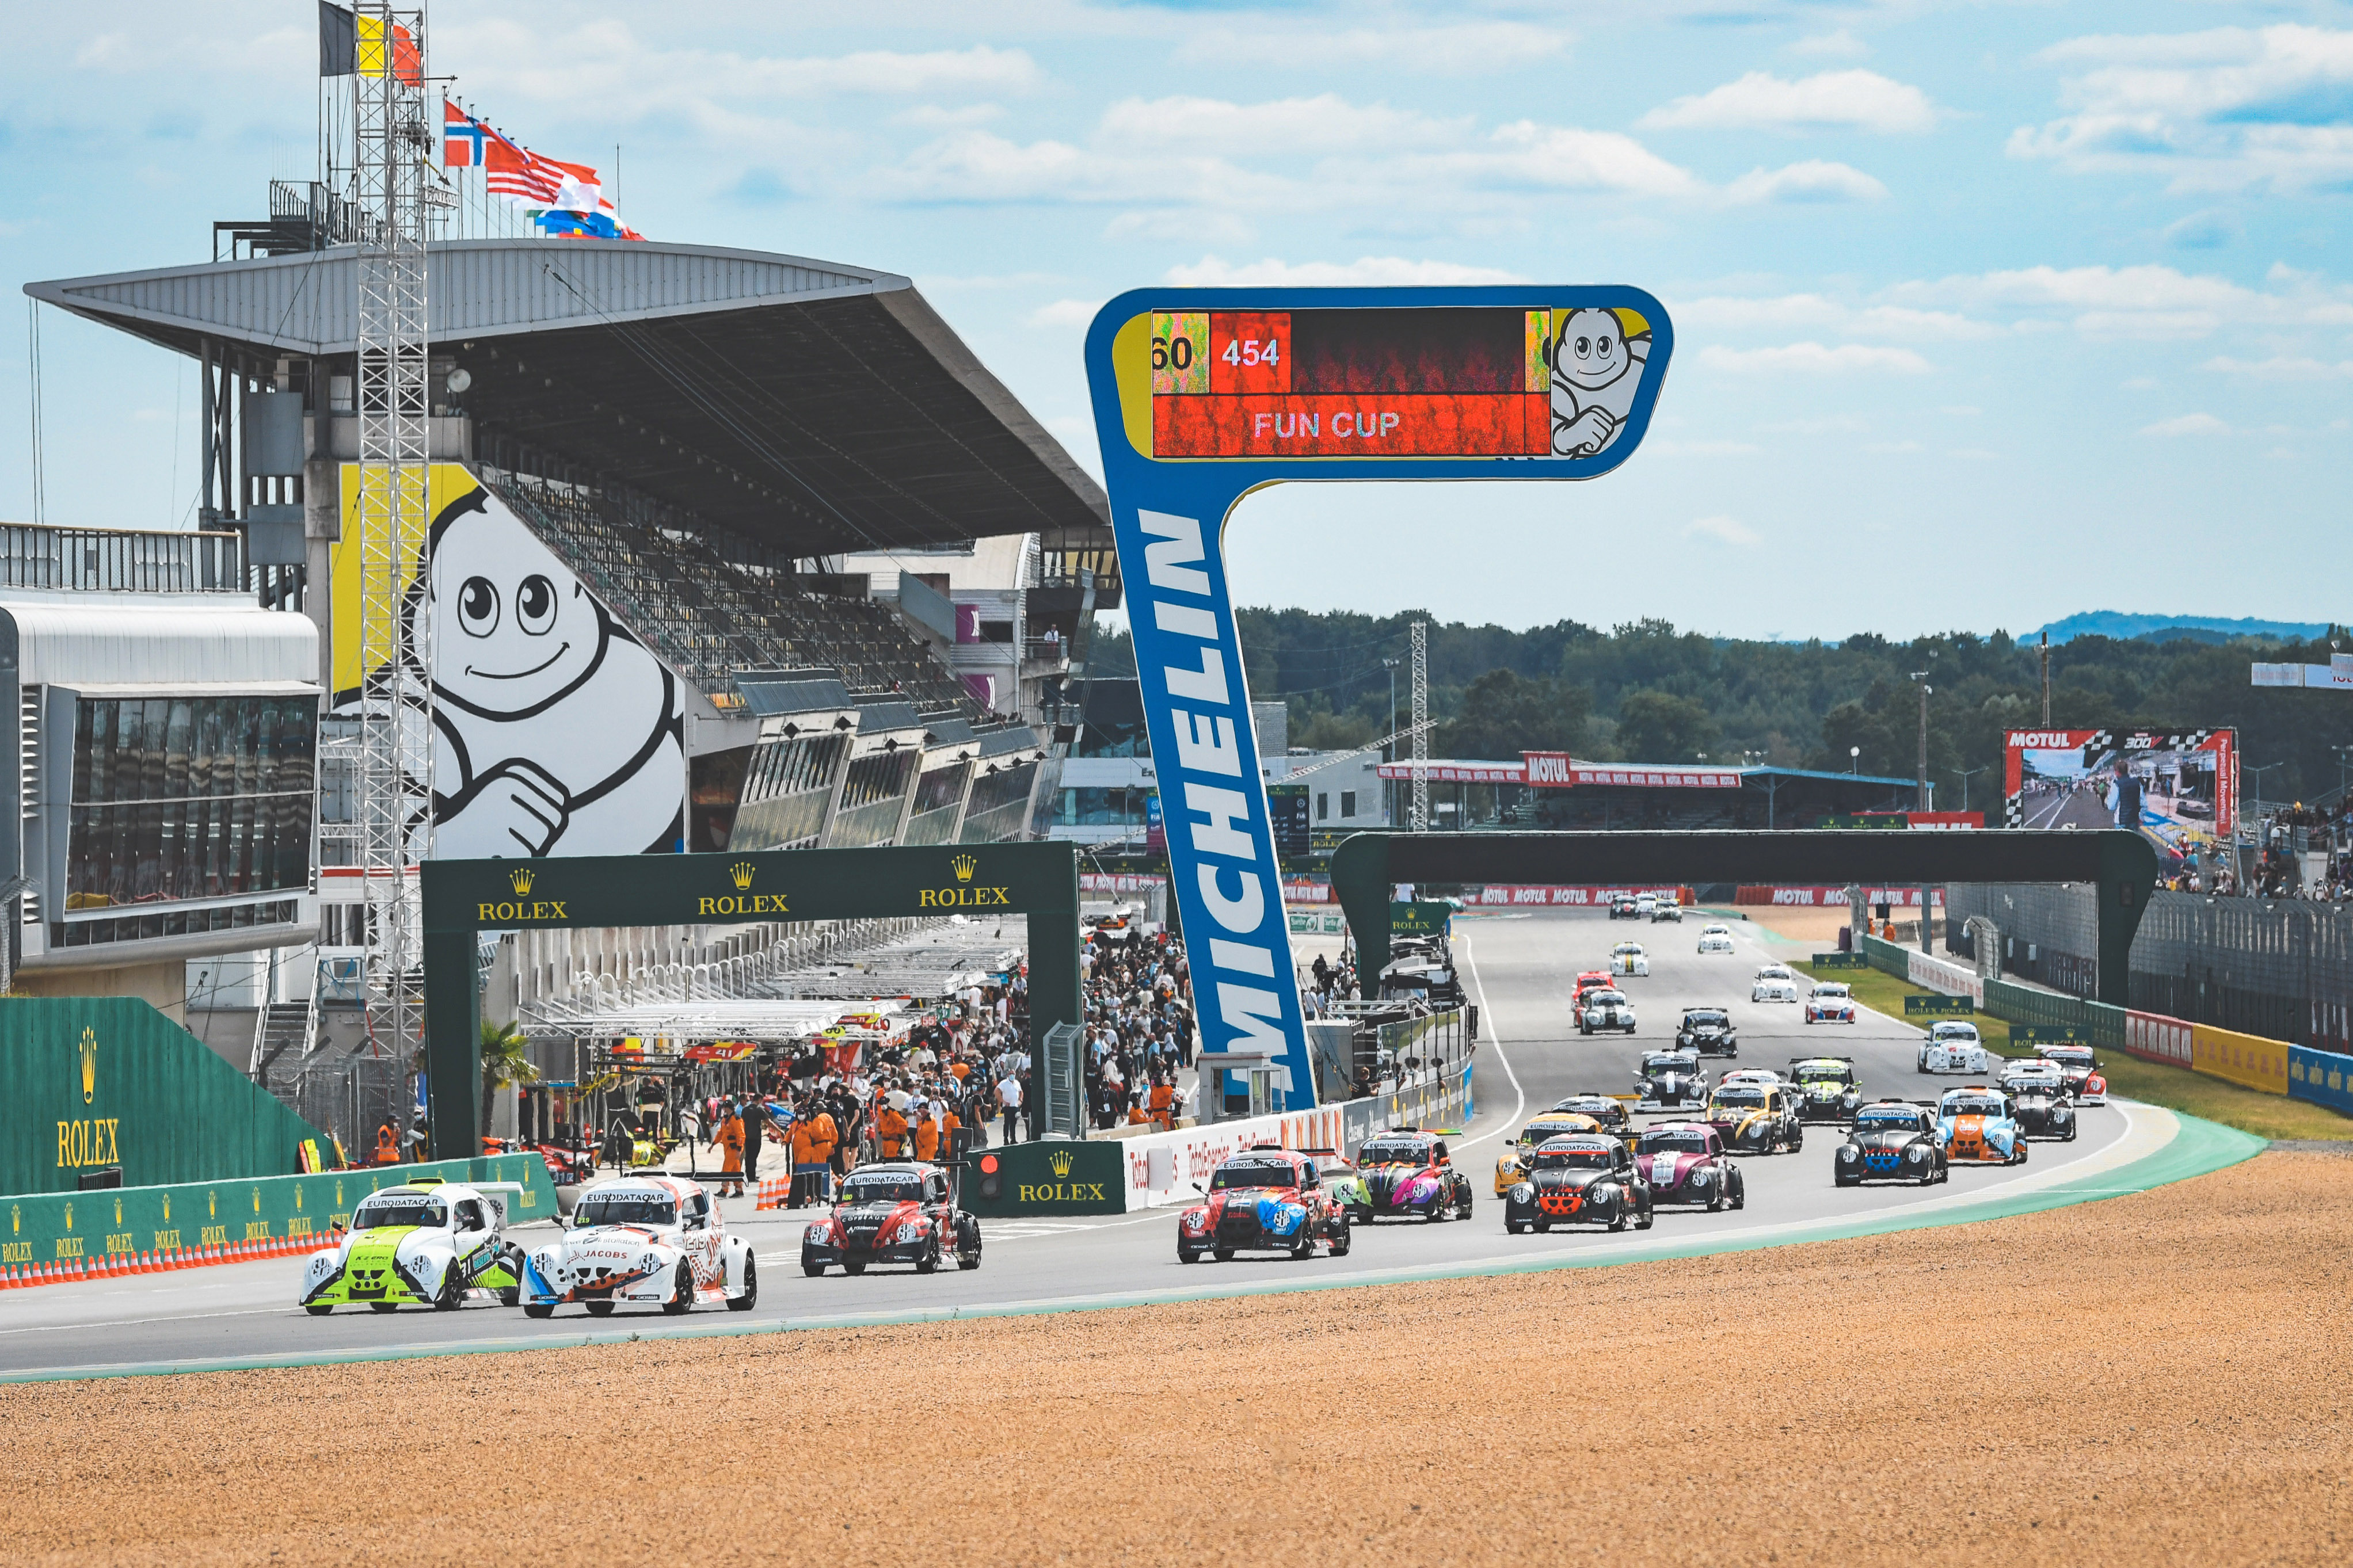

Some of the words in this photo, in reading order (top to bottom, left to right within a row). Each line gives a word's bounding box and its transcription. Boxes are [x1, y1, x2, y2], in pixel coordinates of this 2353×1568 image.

[1222, 339, 1279, 366] 454
[1255, 413, 1320, 437] FUN
[1331, 412, 1399, 437] CUP
[2009, 733, 2070, 747] MOTUL
[2124, 737, 2164, 749] 300V
[1529, 757, 1569, 783] MOTUL
[1137, 508, 1294, 1092] MICHELIN
[698, 894, 789, 915] ROLEX
[919, 887, 1010, 907] ROLEX
[1482, 888, 1509, 903] MOTUL
[1514, 889, 1546, 903] MOTUL
[1553, 889, 1587, 903] MOTUL
[1773, 890, 1814, 904] MOTUL
[477, 901, 568, 921] ROLEX
[1393, 921, 1430, 930] ROLEX
[715, 1049, 733, 1058] 41
[58, 1118, 119, 1168] ROLEX
[587, 1194, 664, 1202] EURODATACAR
[1019, 1183, 1106, 1201] ROLEX
[367, 1199, 438, 1208] EURODATACAR
[201, 1225, 227, 1245] ROLEX
[245, 1221, 271, 1241] ROLEX
[288, 1217, 312, 1236] ROLEX
[56, 1238, 84, 1257] ROLEX
[106, 1233, 134, 1253] ROLEX
[155, 1230, 181, 1249] ROLEX
[686, 1234, 706, 1250] 219
[2, 1242, 32, 1262] ROLEX
[584, 1250, 627, 1259] JACOBS
